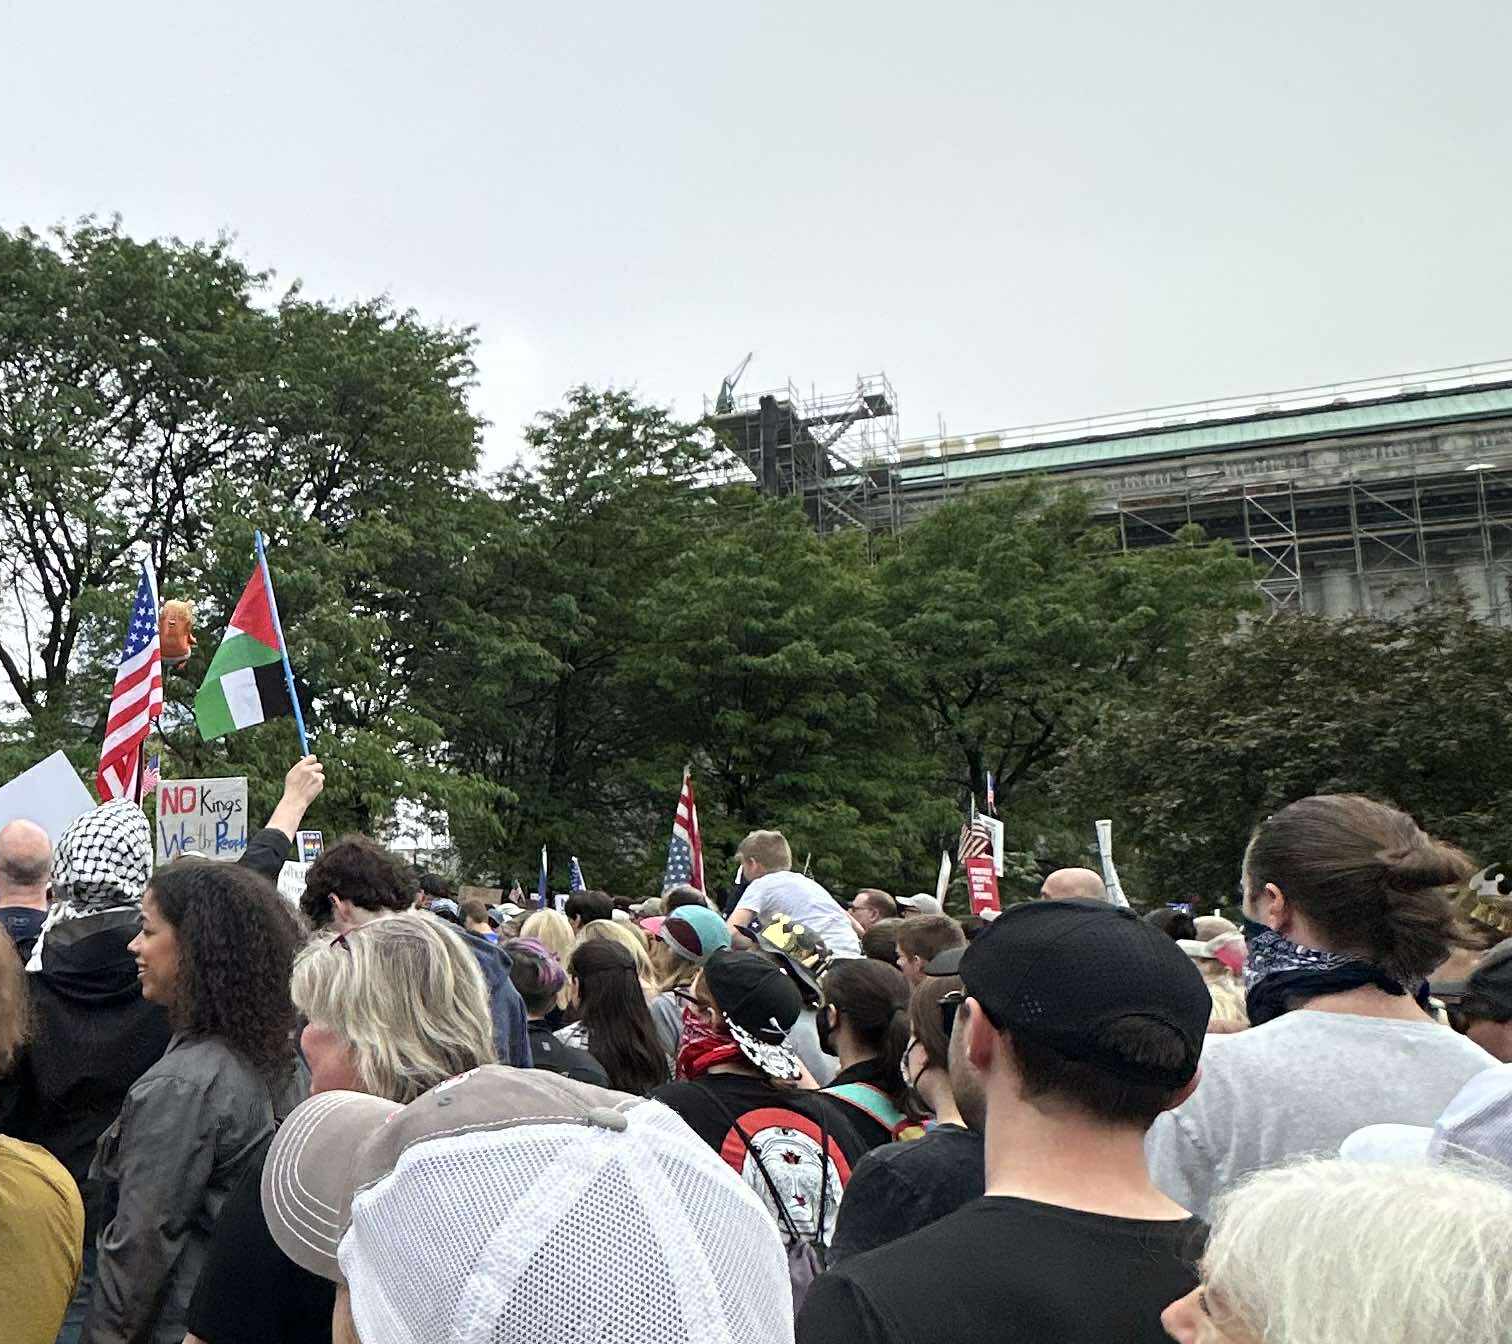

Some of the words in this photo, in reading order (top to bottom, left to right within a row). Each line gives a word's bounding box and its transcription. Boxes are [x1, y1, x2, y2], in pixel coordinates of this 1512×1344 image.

[161, 785, 197, 817] NO
[200, 785, 242, 821] Kings
[159, 819, 197, 858] We
